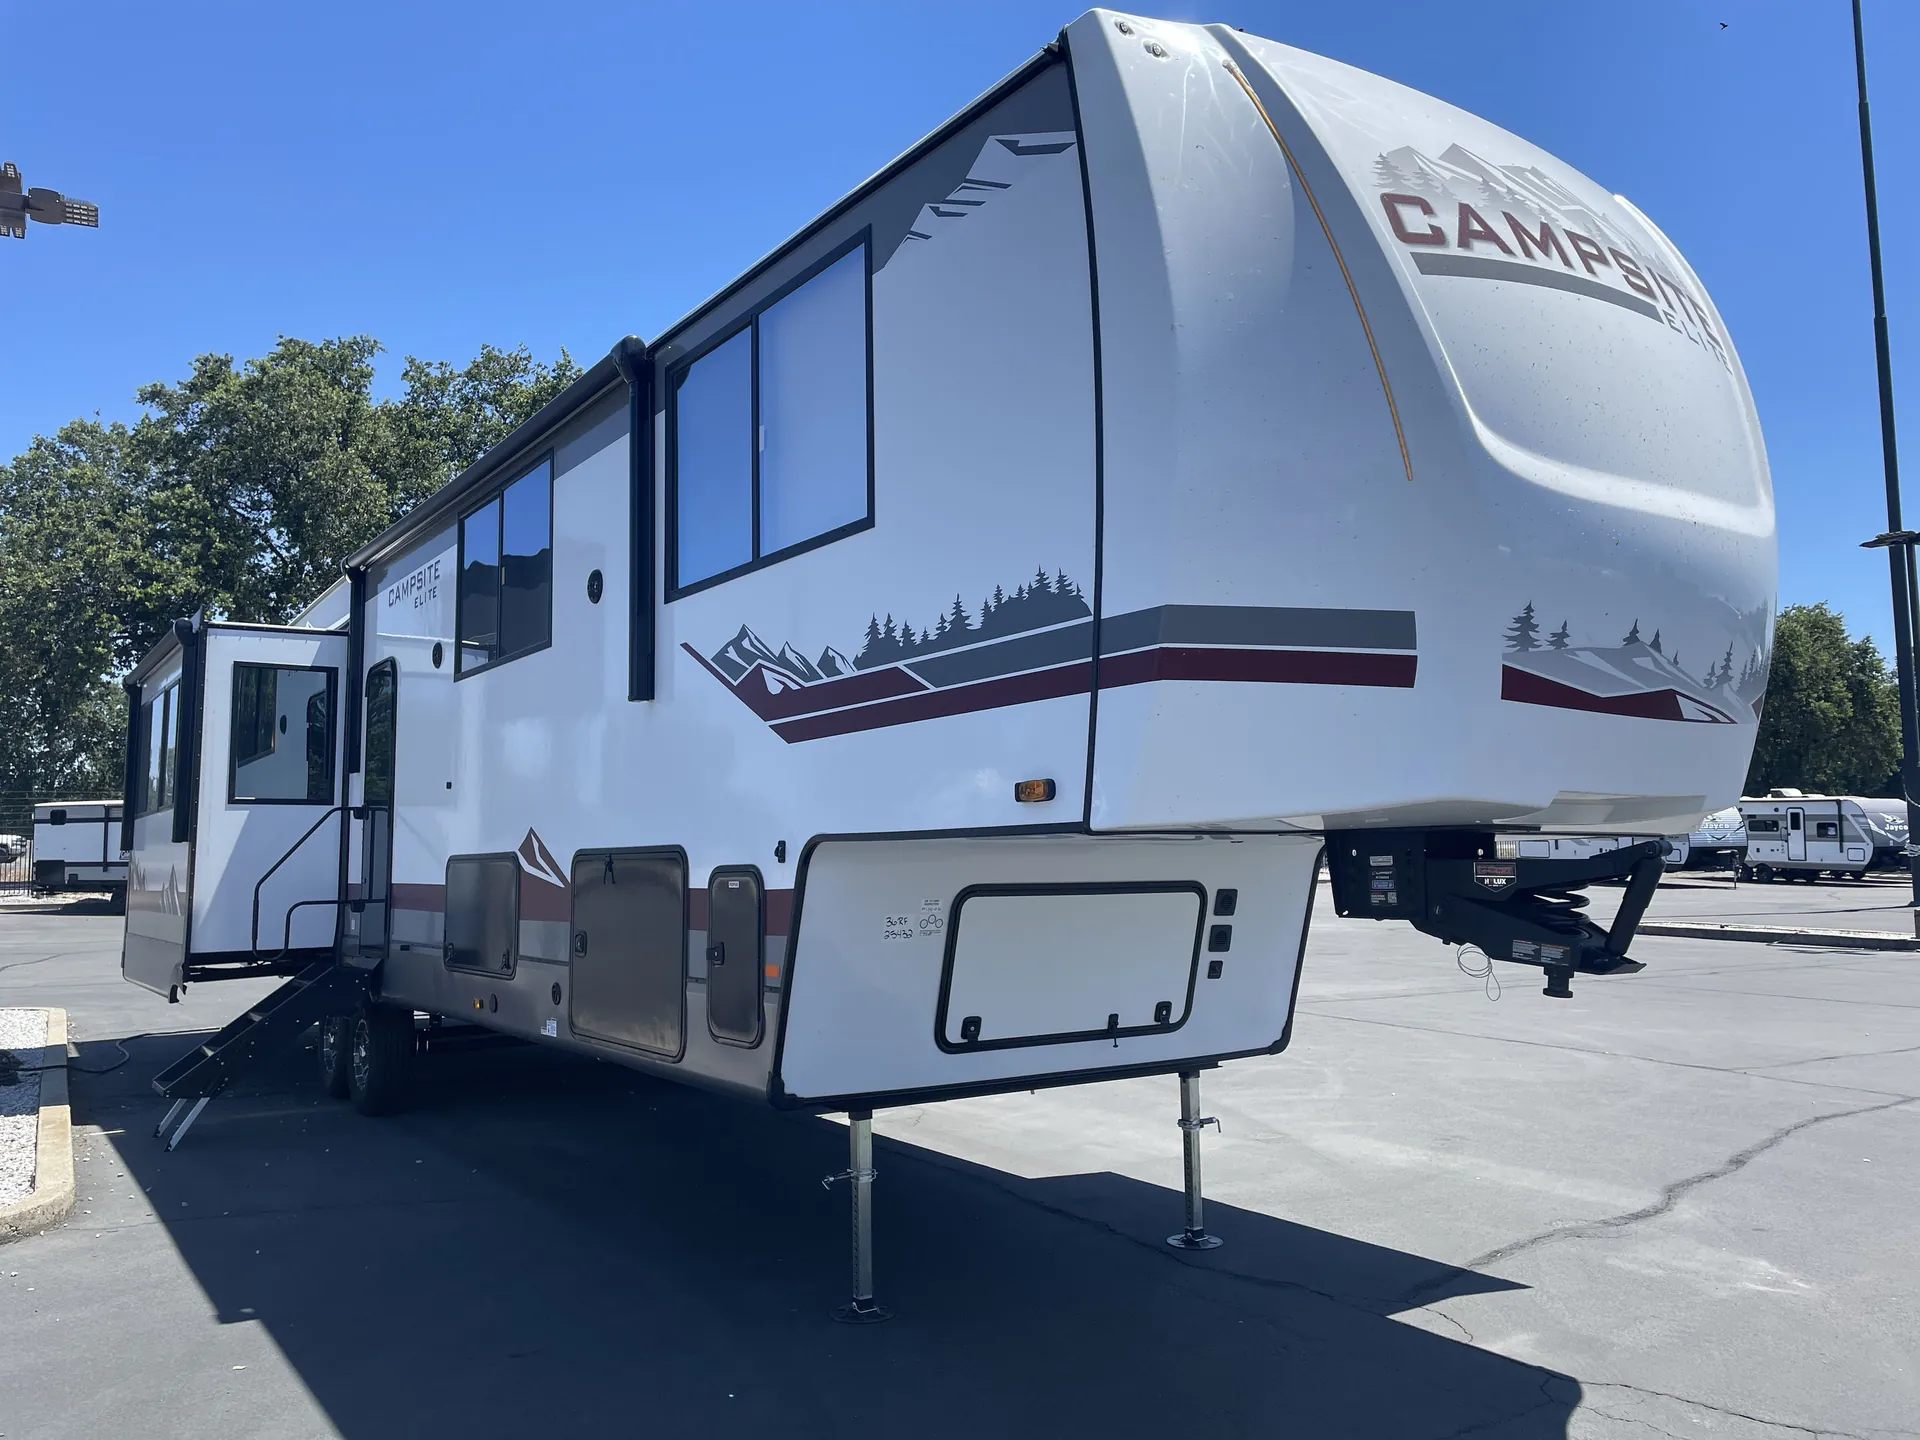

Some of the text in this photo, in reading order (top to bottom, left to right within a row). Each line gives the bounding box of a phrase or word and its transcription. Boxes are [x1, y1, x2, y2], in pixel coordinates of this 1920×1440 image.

[1380, 192, 1725, 354] CAMPSITE
[1662, 308, 1733, 376] ELITE
[388, 560, 440, 608] CAMPSITE
[414, 586, 437, 609] ELITE
[1703, 822, 1730, 831] Jayco
[1884, 823, 1909, 831] Jayco
